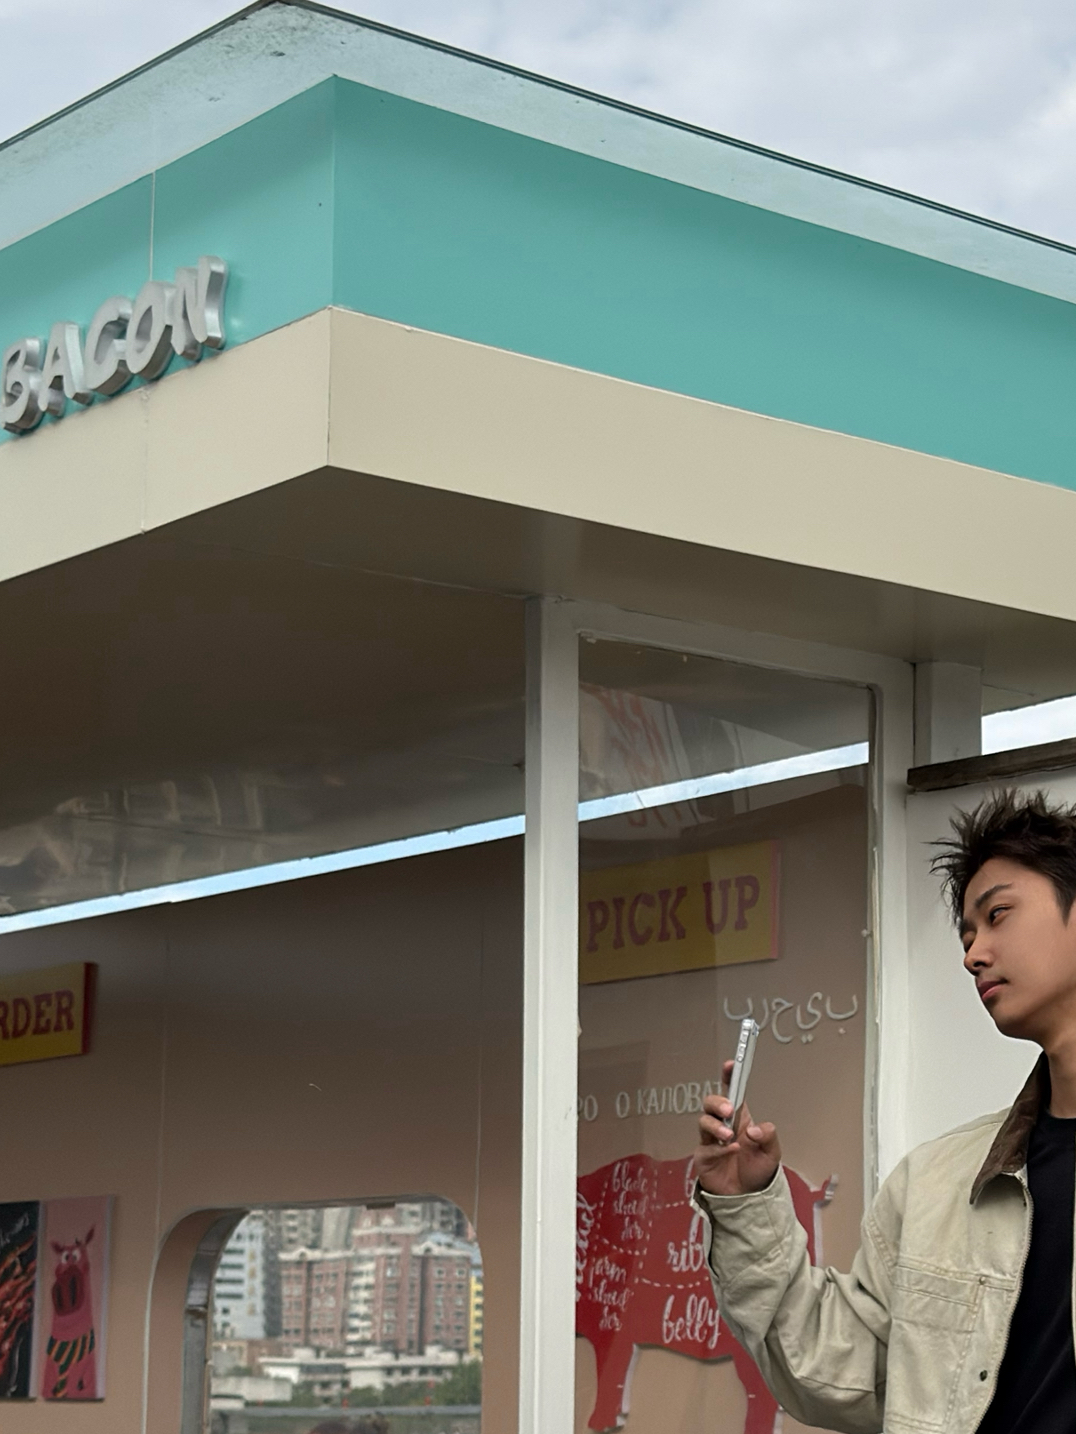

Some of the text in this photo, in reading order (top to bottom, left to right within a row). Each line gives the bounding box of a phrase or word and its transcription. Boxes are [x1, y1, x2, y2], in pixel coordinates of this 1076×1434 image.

[0, 255, 228, 434] BACON
[586, 875, 760, 953] PICK UP
[663, 1293, 722, 1349] belly
